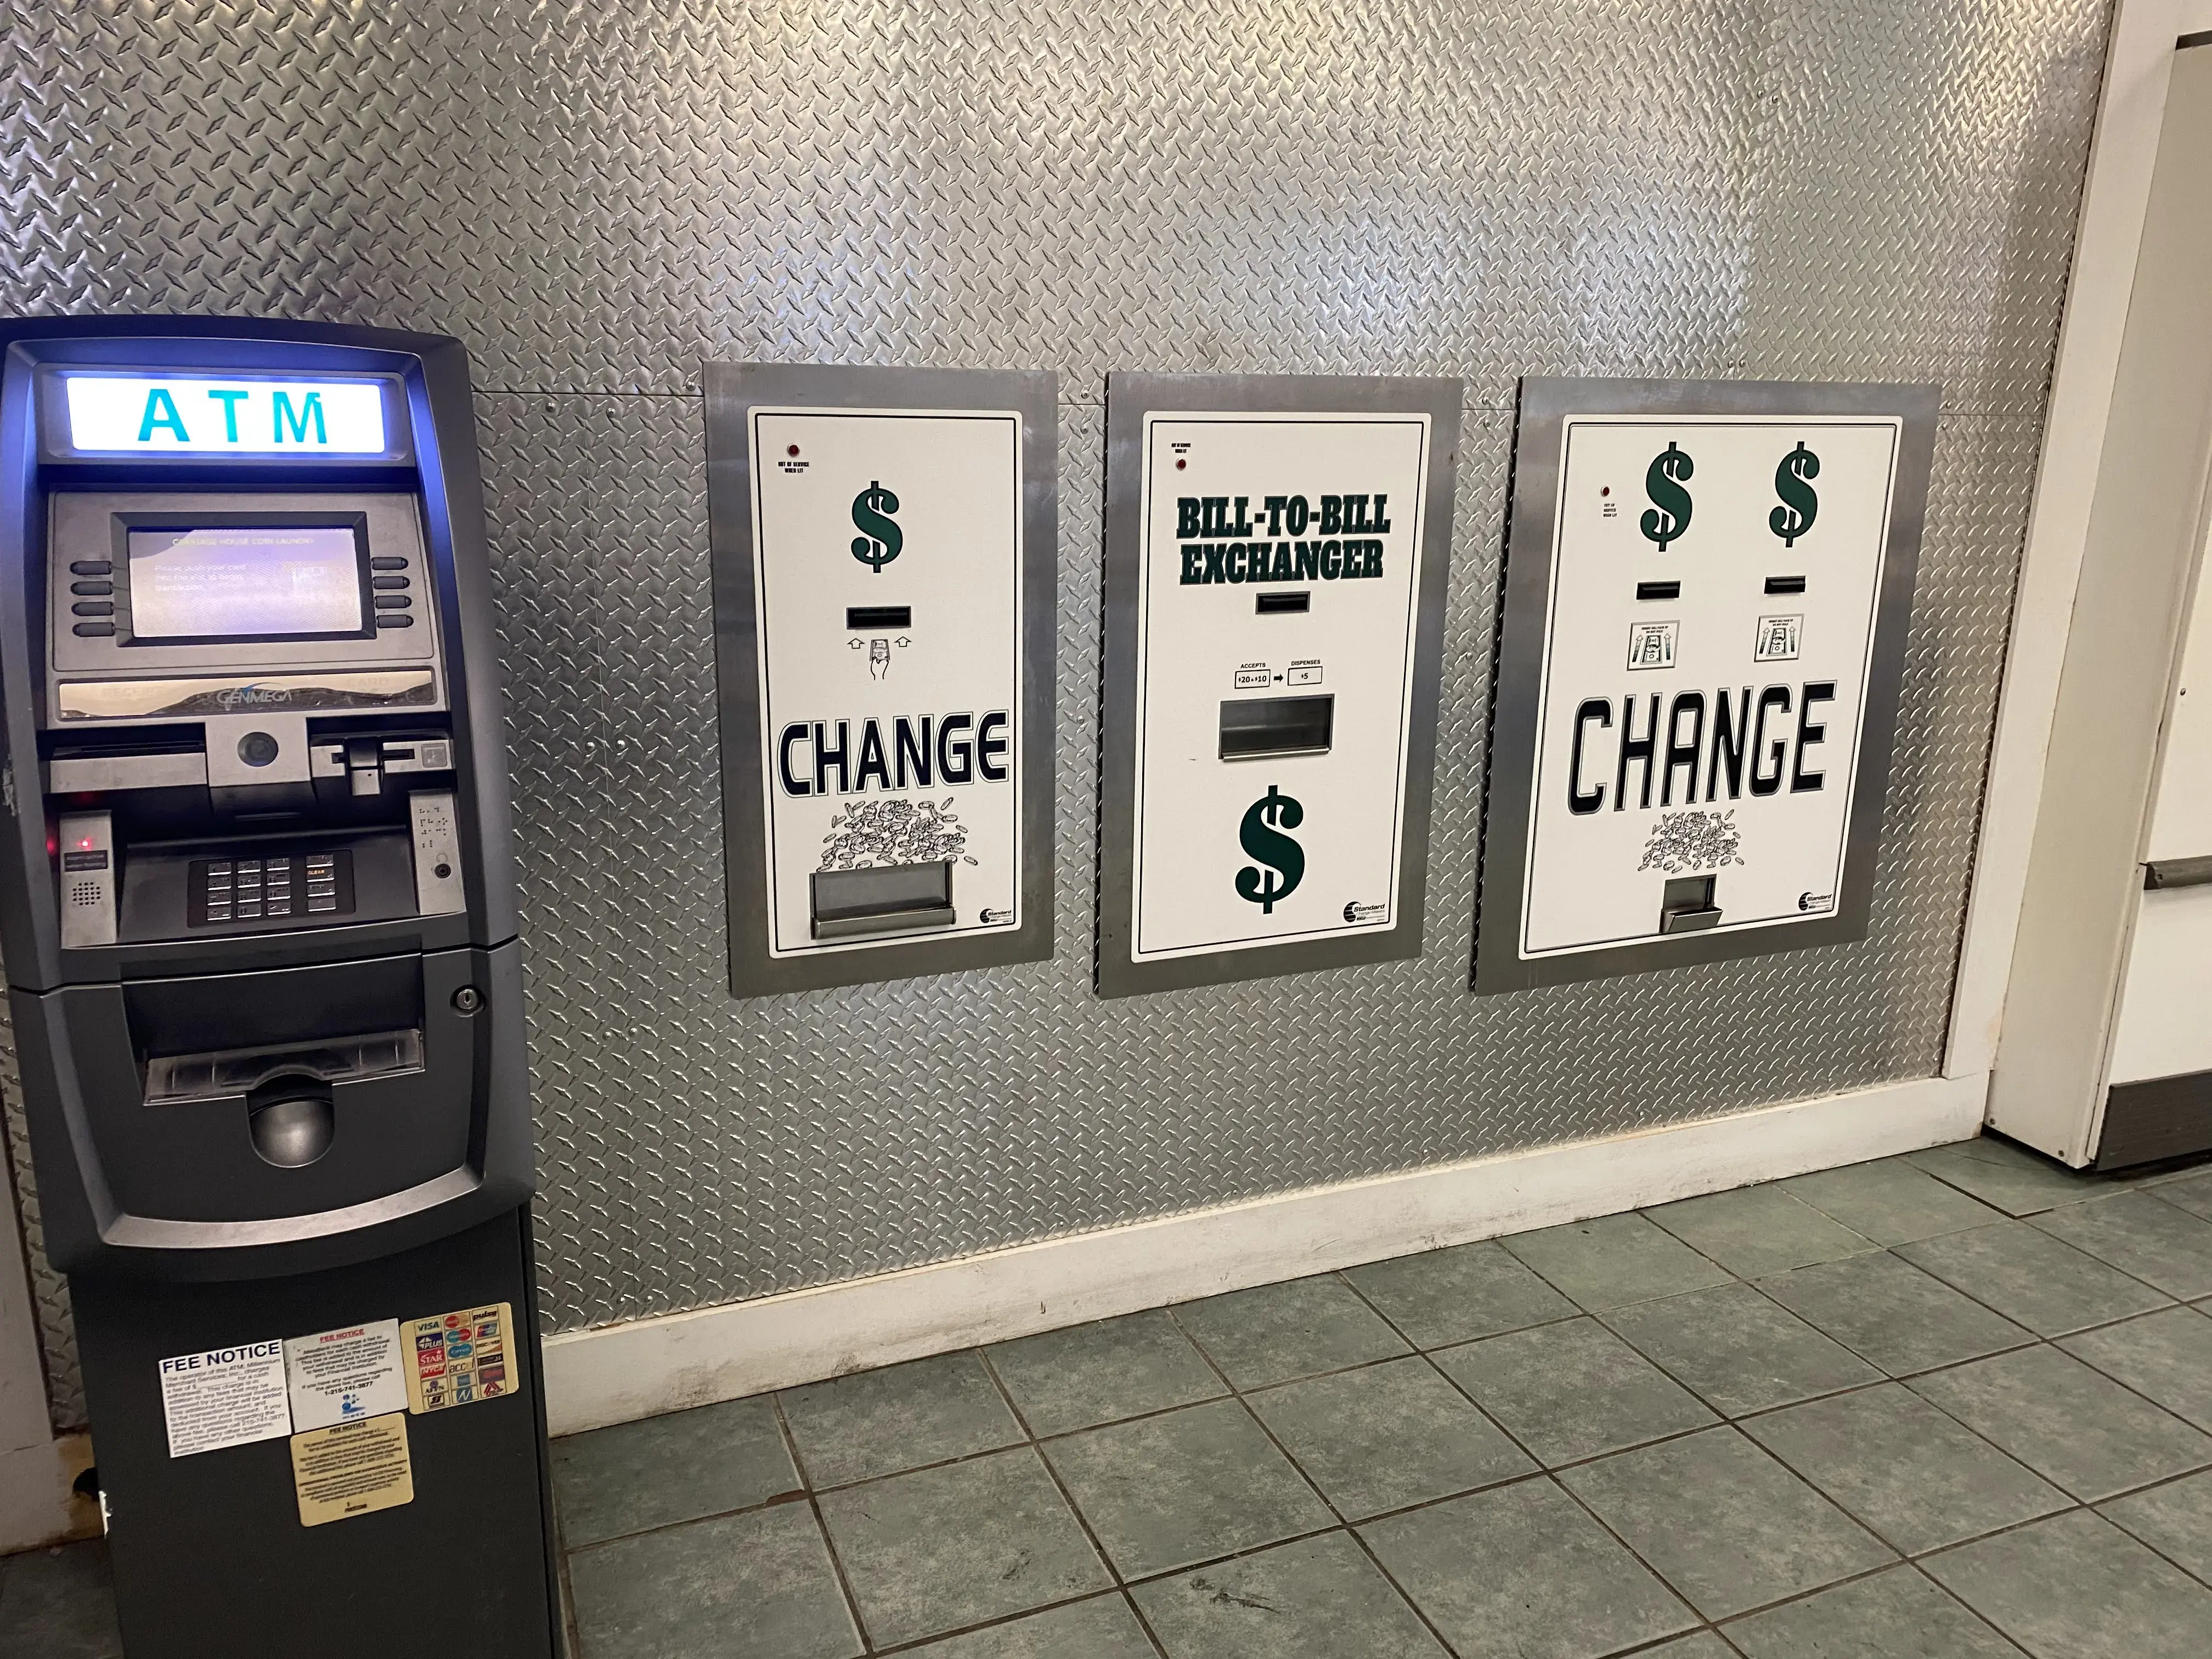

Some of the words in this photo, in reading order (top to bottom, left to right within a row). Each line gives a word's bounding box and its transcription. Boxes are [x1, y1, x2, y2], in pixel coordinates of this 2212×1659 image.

[138, 388, 328, 444] ATM
[1176, 494, 1391, 539] BILL-TO-BILL
[1180, 539, 1384, 585] EXCHANGER
[216, 689, 292, 704] GENMEGA
[777, 709, 1009, 798] CHANGE
[1567, 680, 1838, 815] CHANGE
[1354, 903, 1385, 912] Standard
[320, 1335, 334, 1343] FEE
[336, 1329, 364, 1340] NOTICE
[417, 1321, 439, 1331] VISA
[423, 1339, 442, 1349] PLUS
[162, 1356, 200, 1374] FEE
[206, 1342, 280, 1365] NOTICE
[420, 1353, 443, 1365] STAR
